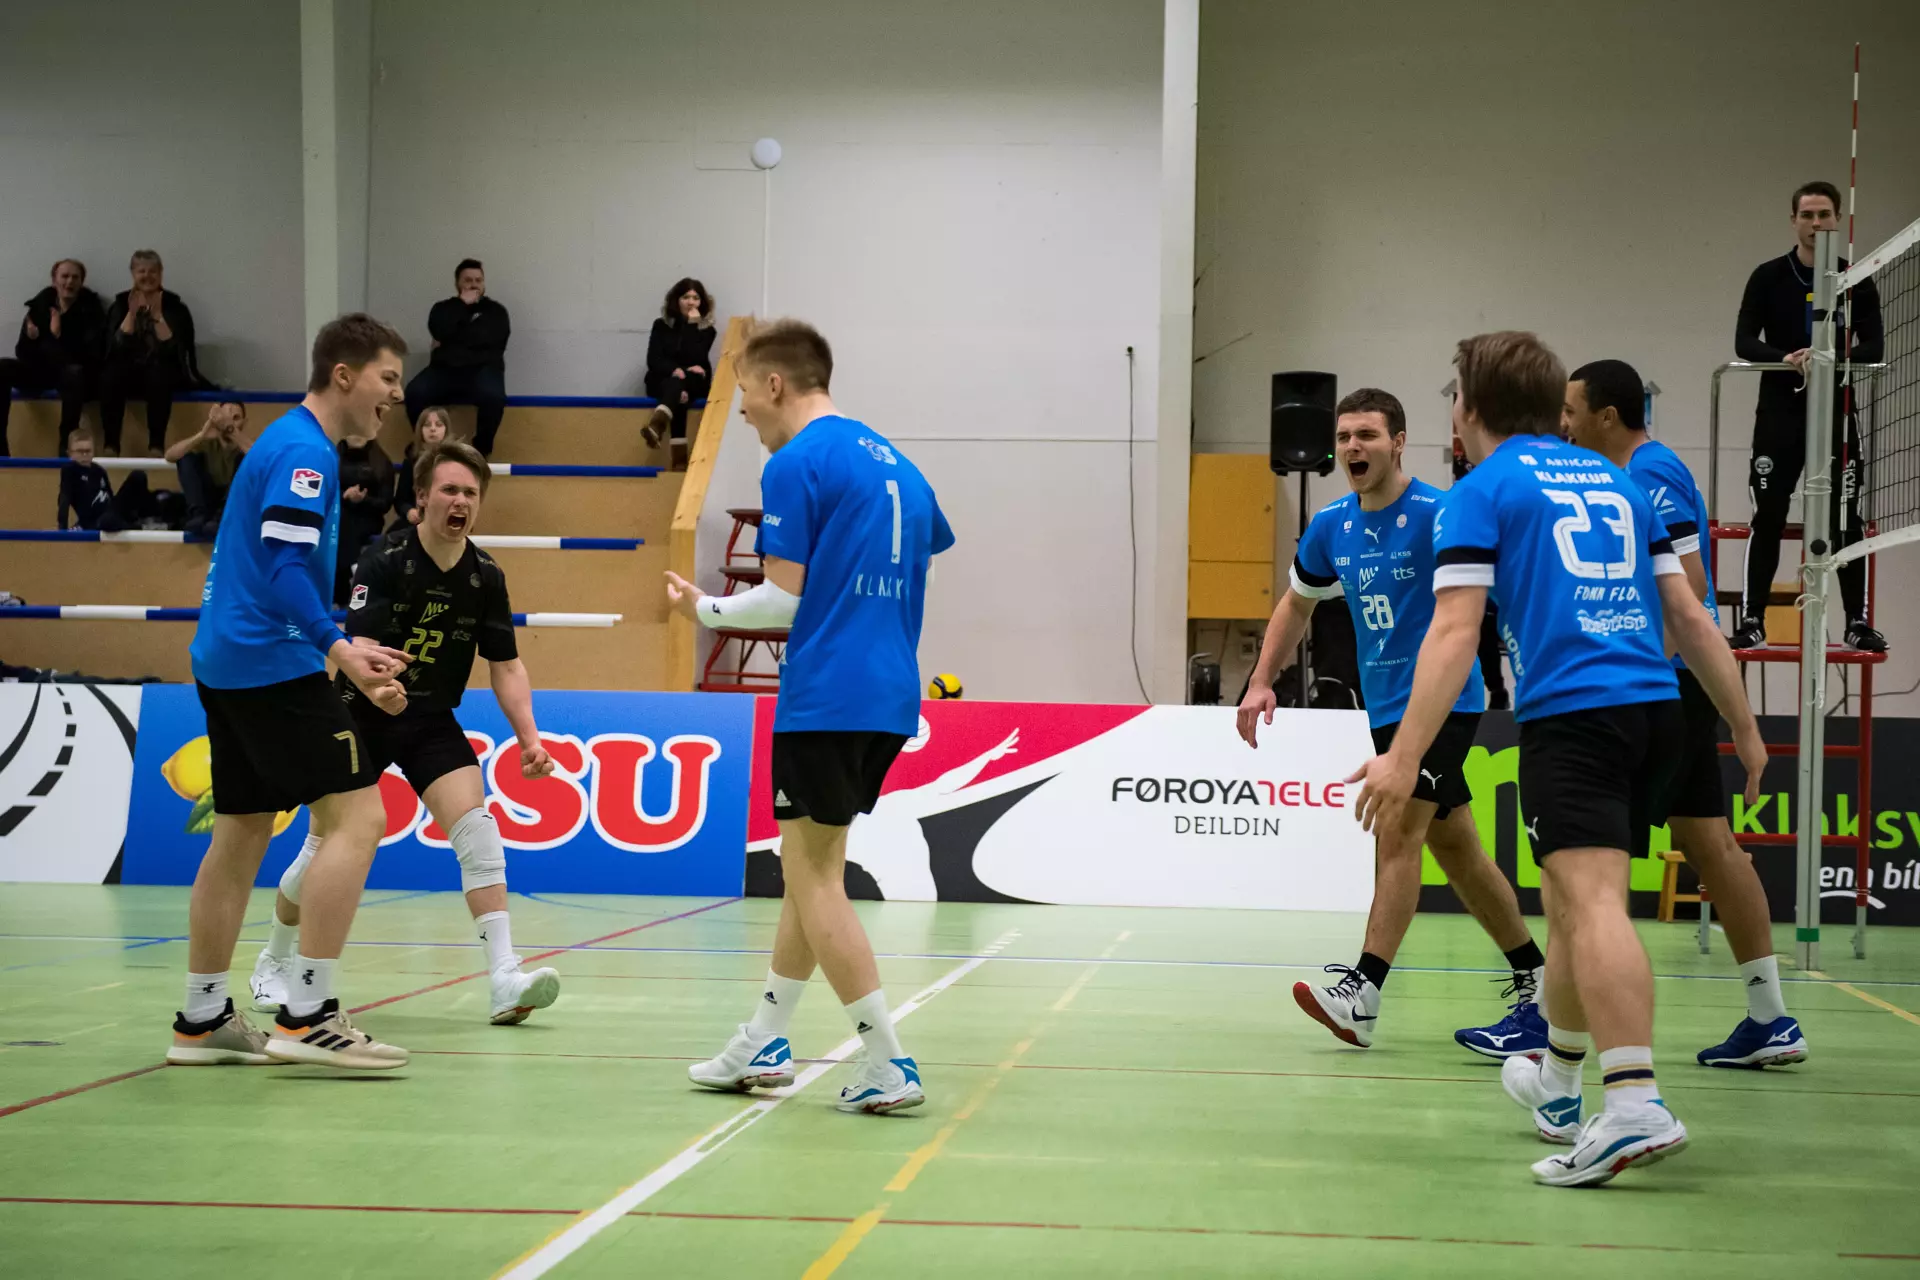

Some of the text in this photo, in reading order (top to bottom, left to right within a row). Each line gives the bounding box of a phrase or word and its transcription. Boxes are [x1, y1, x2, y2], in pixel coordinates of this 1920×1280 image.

[1534, 470, 1614, 484] KLAKKUR
[885, 479, 902, 564] 1
[1541, 488, 1637, 579] 23
[1359, 594, 1395, 631] 28
[403, 626, 444, 664] 22
[332, 730, 359, 774] 7
[378, 731, 722, 853] SU
[1174, 815, 1281, 836] DEILDIN
[1733, 792, 1920, 849] Klks
